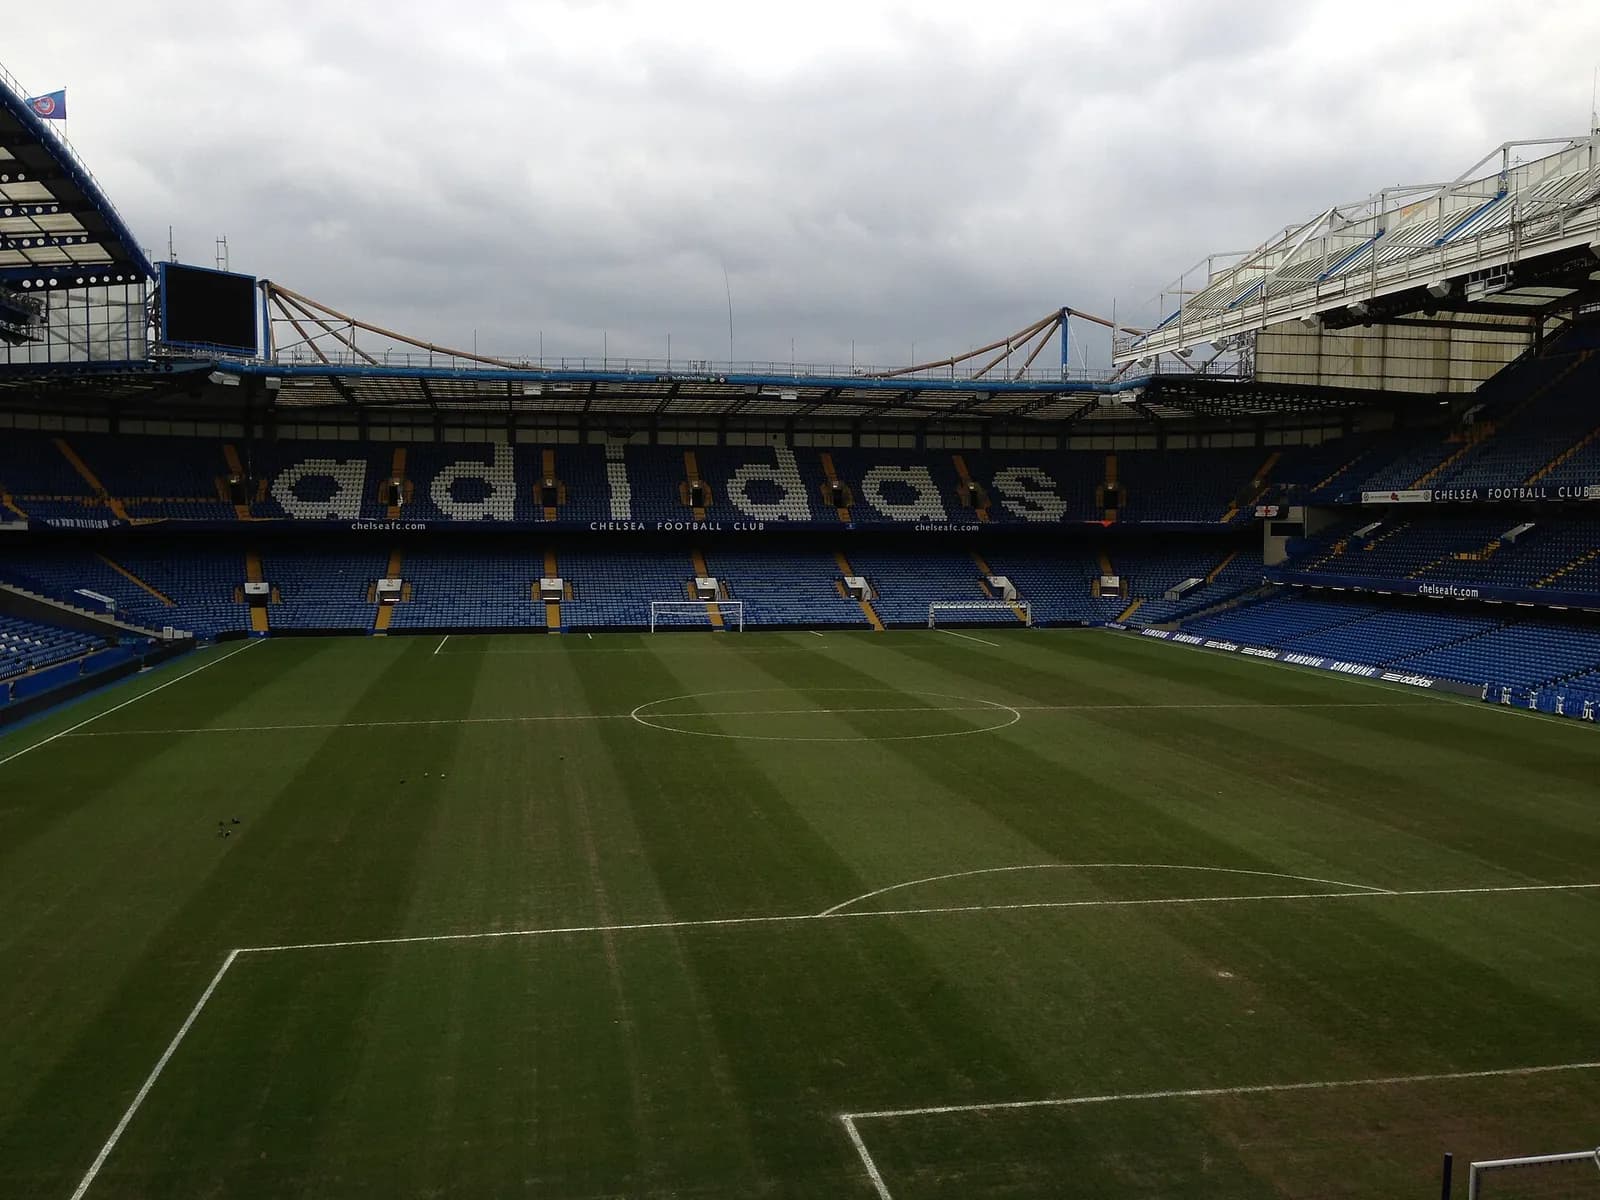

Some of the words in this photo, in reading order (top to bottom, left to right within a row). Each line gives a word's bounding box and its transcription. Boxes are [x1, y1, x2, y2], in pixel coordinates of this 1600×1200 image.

[270, 440, 1068, 522] adidas
[1434, 489, 1479, 500] CHELSEA
[1488, 487, 1547, 499] FOOTBALL
[1558, 486, 1589, 498] CLUB
[351, 521, 426, 531] chelseafc.com
[590, 521, 646, 531] CHELSEA
[657, 521, 722, 531] FOOTBALL
[733, 522, 766, 531] CLUB
[915, 523, 979, 531] chelseafc.com
[1418, 584, 1479, 598] chelseafc.com
[1284, 654, 1325, 667] SAMSUNG
[1331, 662, 1375, 676] SAMSUNG
[1400, 675, 1433, 687] adidas
